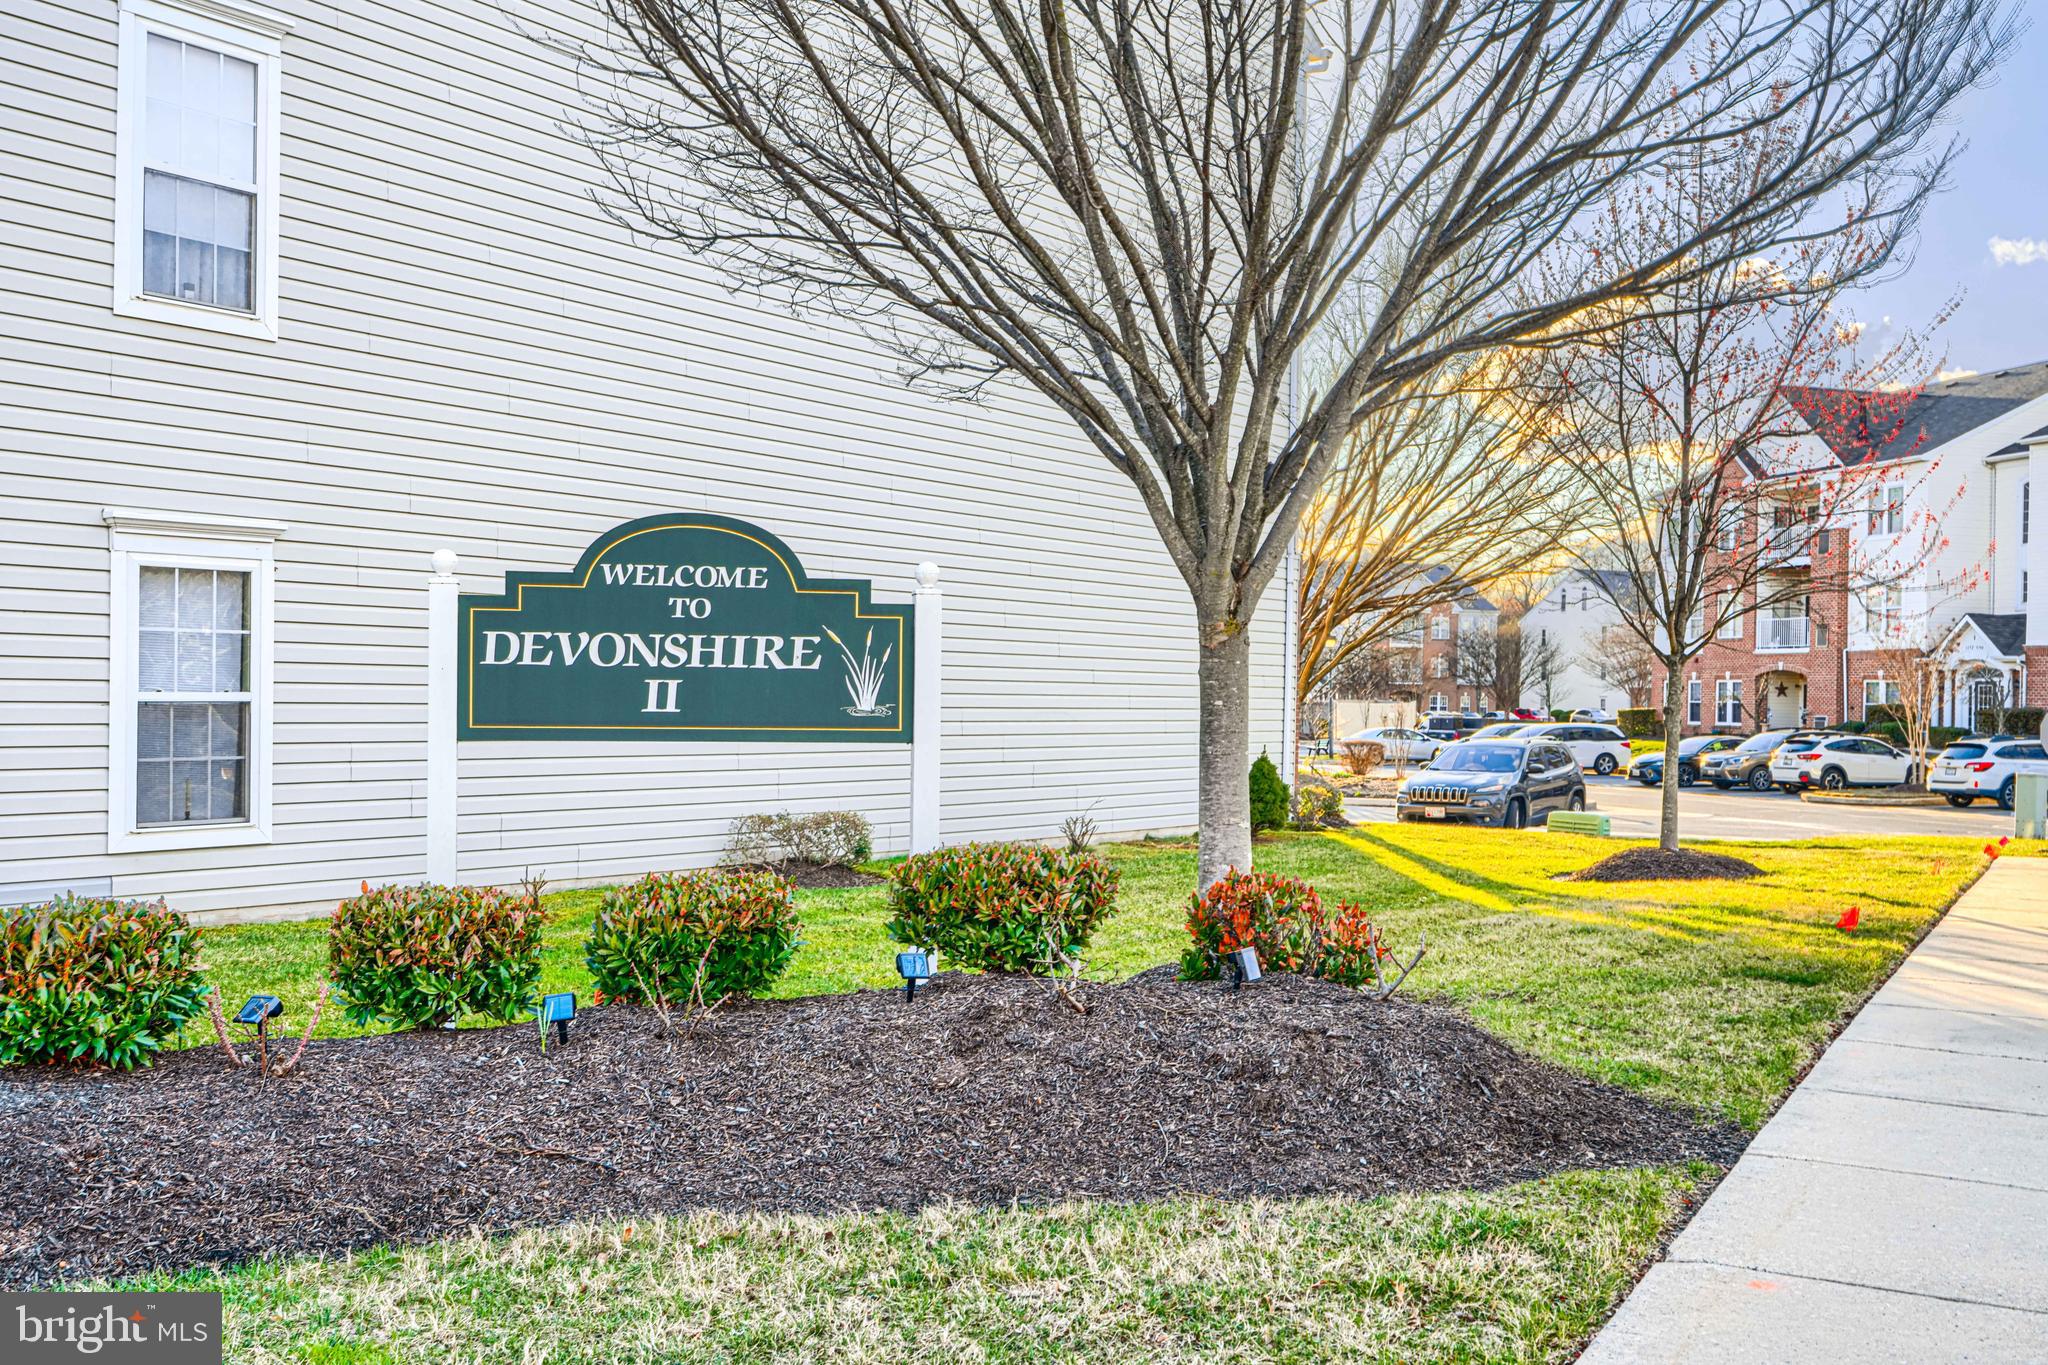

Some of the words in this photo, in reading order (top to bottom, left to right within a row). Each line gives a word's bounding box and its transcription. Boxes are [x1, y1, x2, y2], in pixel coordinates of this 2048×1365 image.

[600, 563, 769, 589] WELCOME
[668, 597, 712, 619] TO
[479, 630, 822, 670] DEVONSHIRE
[641, 679, 684, 713] II
